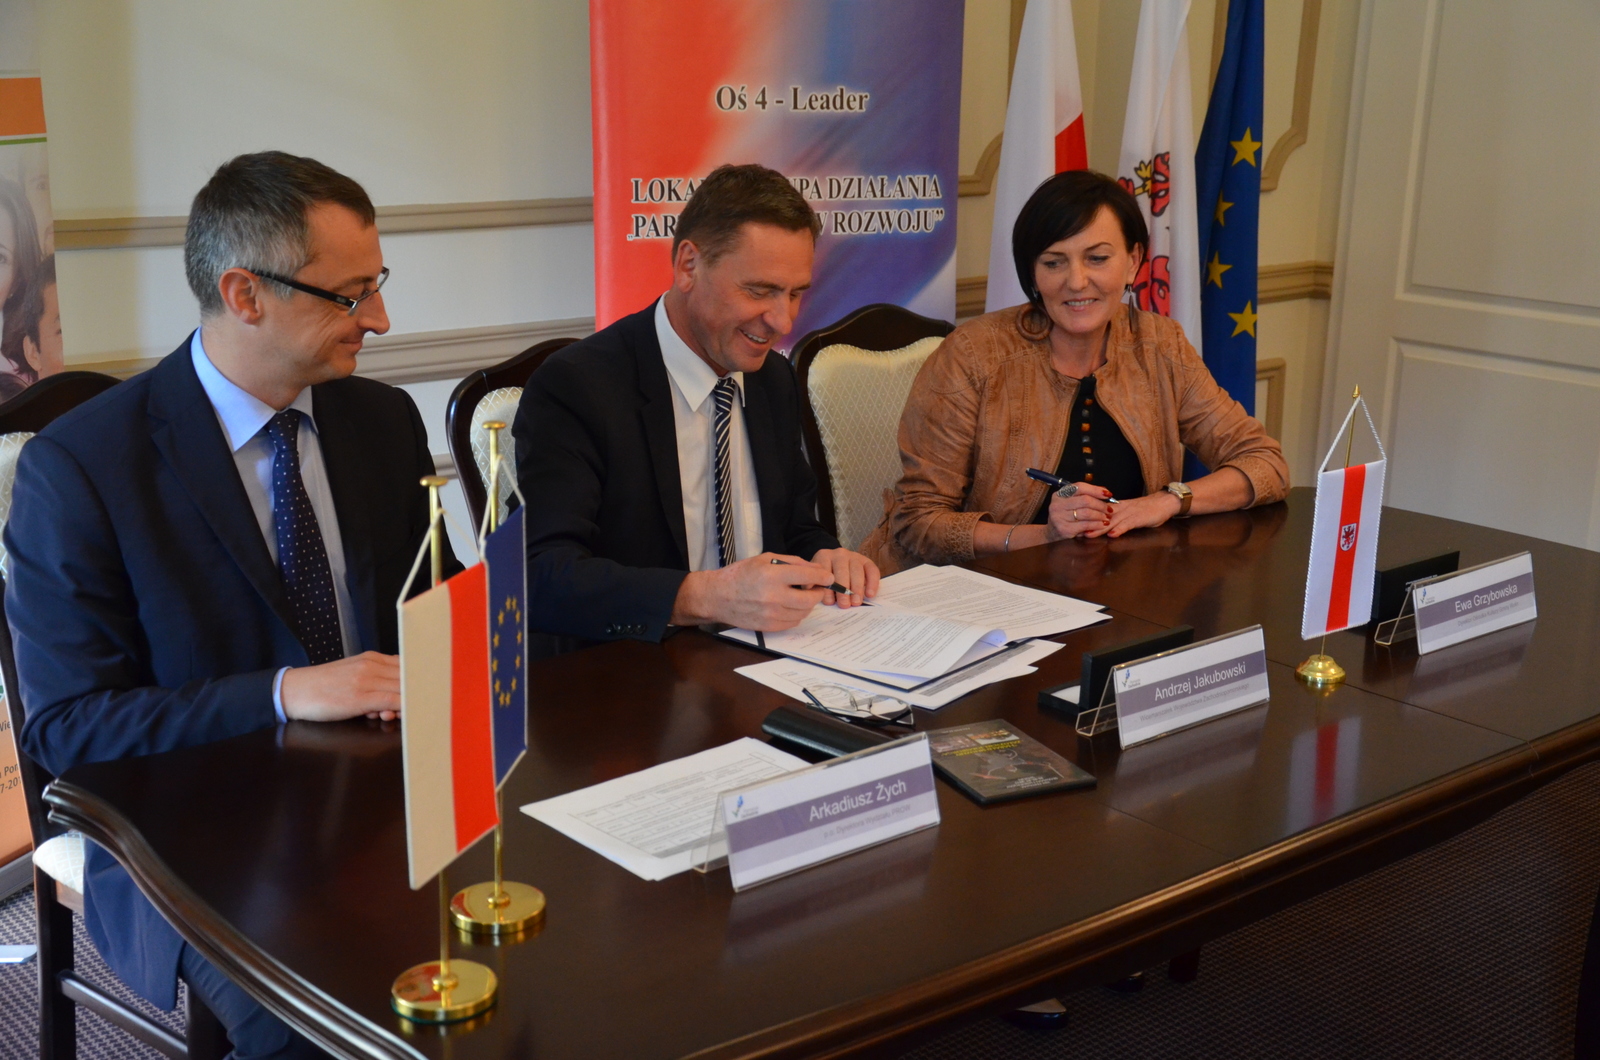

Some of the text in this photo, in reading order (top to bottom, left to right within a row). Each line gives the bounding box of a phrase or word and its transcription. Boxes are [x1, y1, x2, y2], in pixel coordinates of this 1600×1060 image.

[715, 85, 747, 111] Oś
[754, 86, 768, 110] 4
[791, 86, 869, 111] Leader
[631, 178, 705, 203] LOKA
[827, 174, 942, 200] DZIAŁANIA
[1455, 599, 1472, 613] Ewa
[1473, 584, 1518, 606] Grzybowska
[1154, 661, 1247, 702] Andrzej Jakubowski
[809, 779, 907, 822] Arkadiusz Żych
